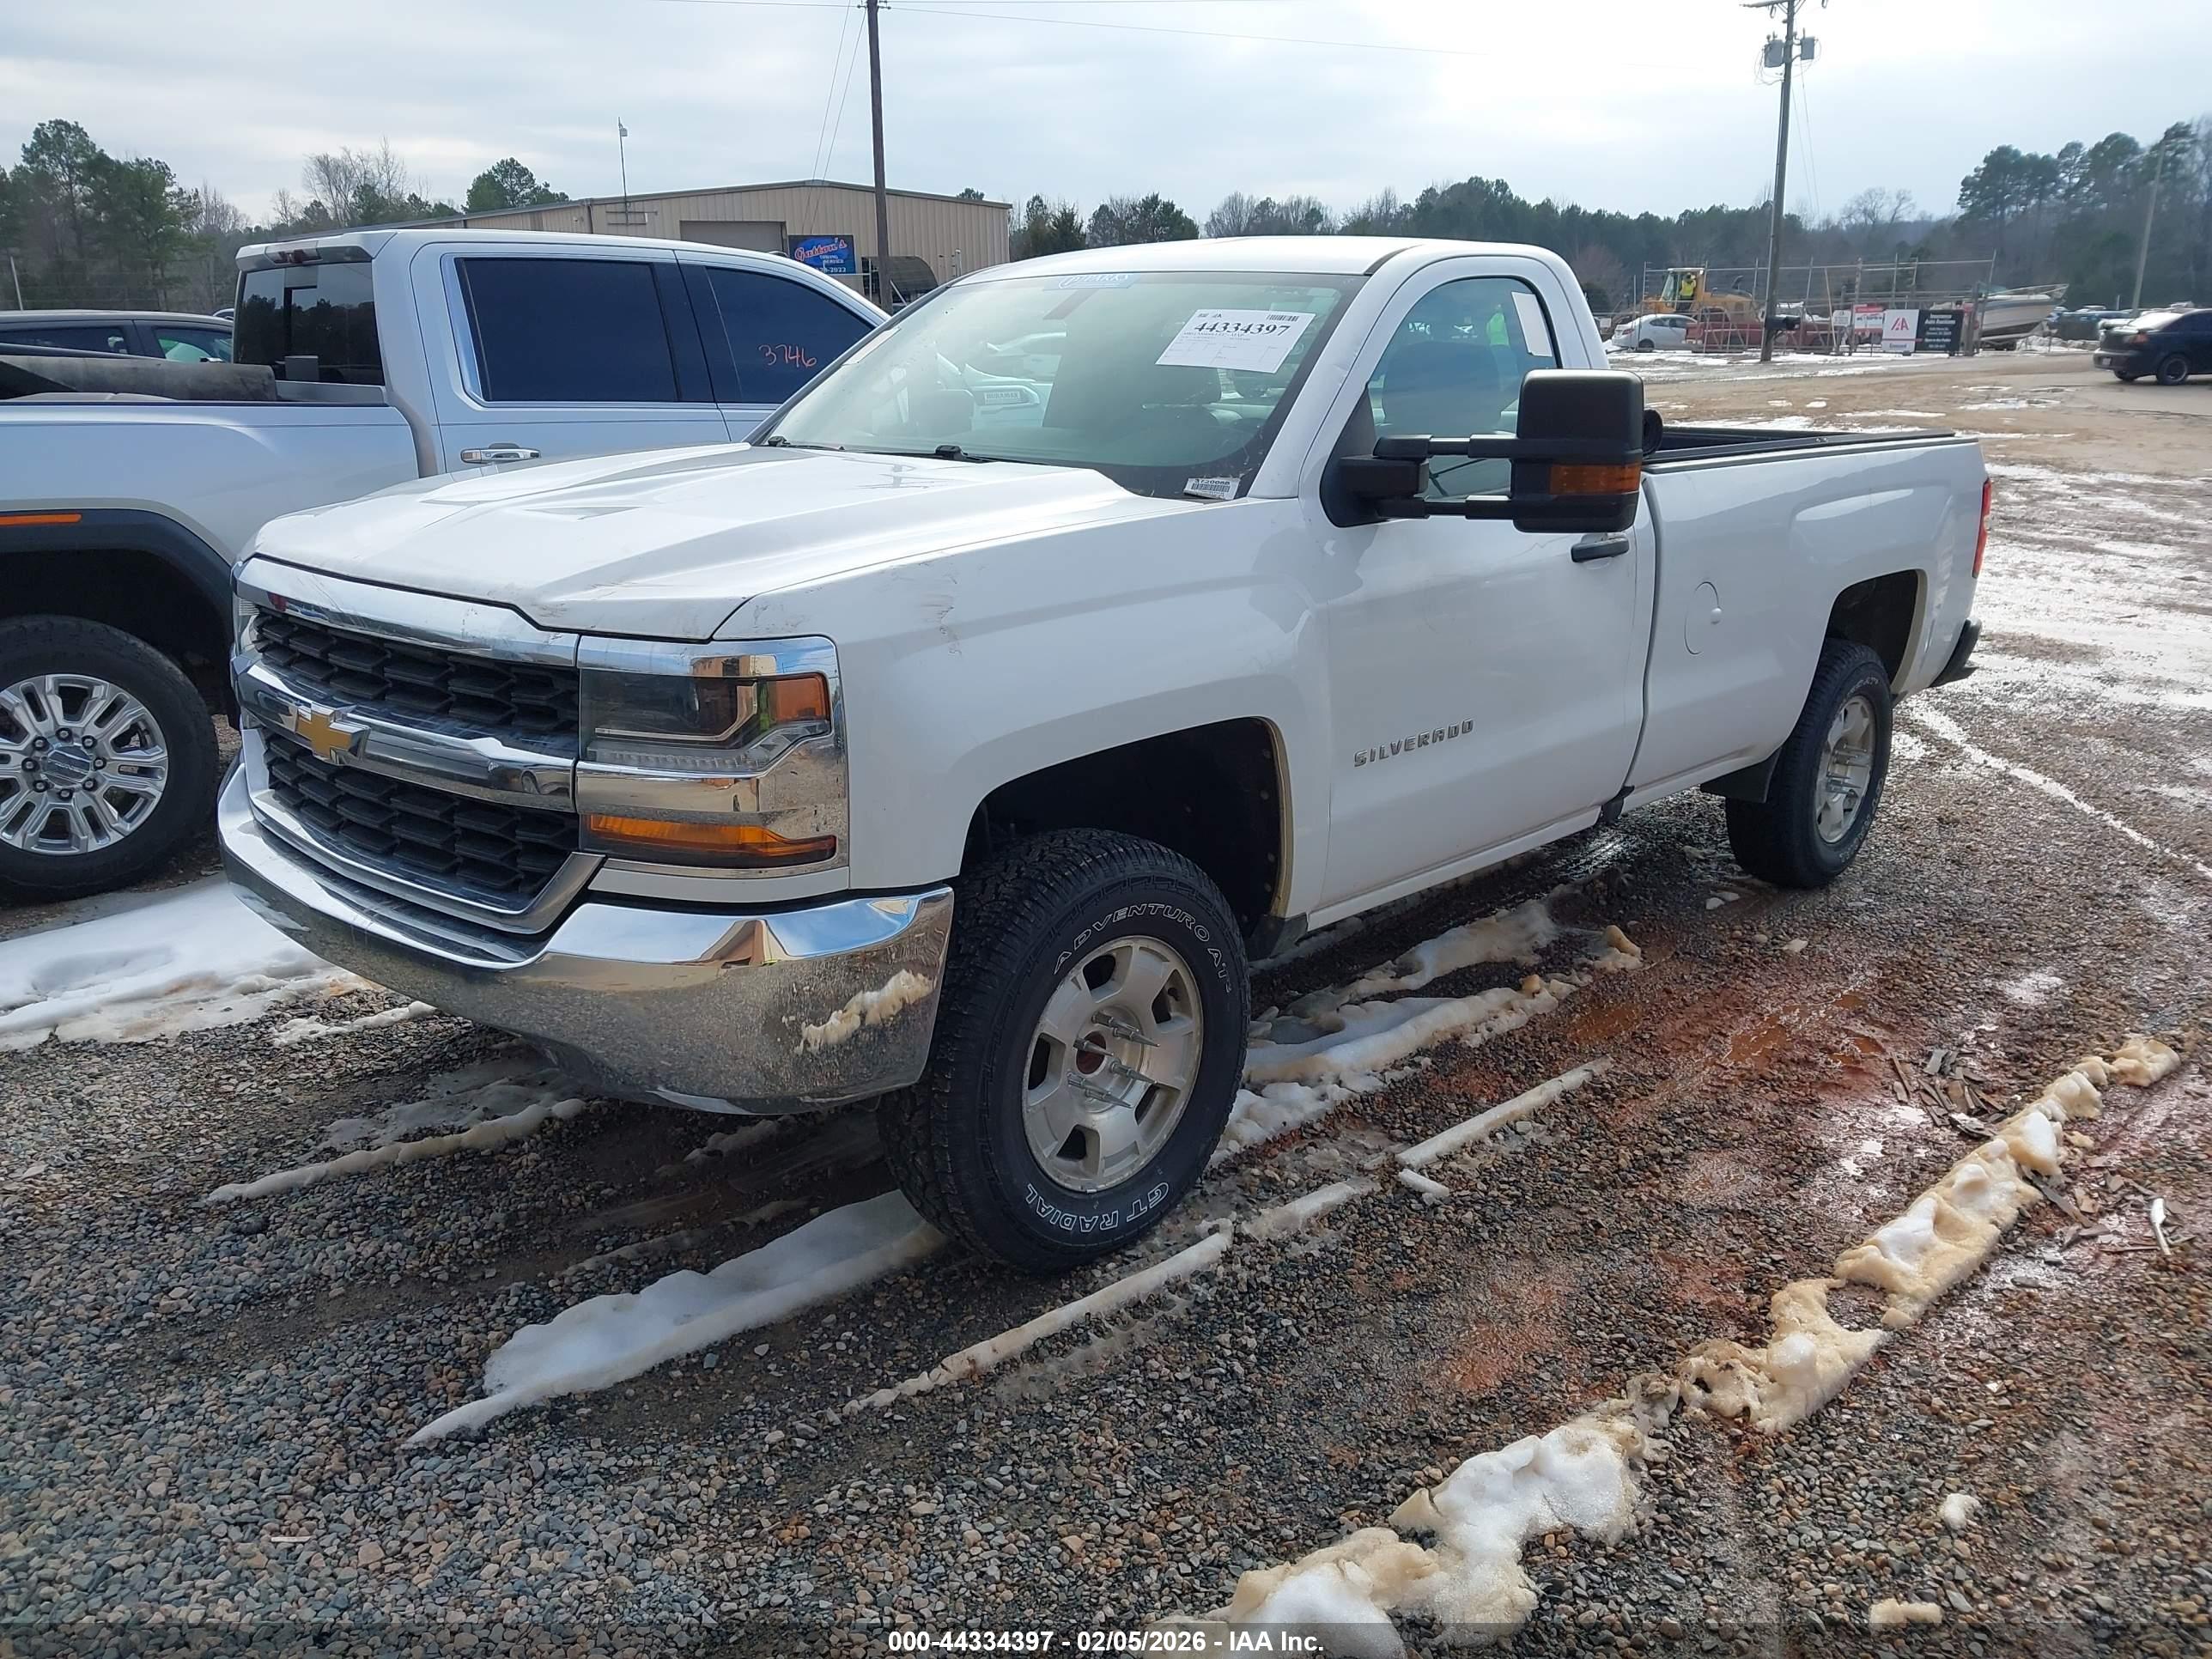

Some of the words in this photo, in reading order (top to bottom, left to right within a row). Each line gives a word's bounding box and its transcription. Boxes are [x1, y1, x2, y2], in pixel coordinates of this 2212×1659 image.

[1194, 321, 1291, 337] 44334397
[758, 344, 817, 368] 3746
[1354, 718, 1474, 767] SILVERADO
[1054, 902, 1210, 975] ADVENTURO
[1025, 1182, 1119, 1233] RADIAL
[1127, 1182, 1170, 1222] GT
